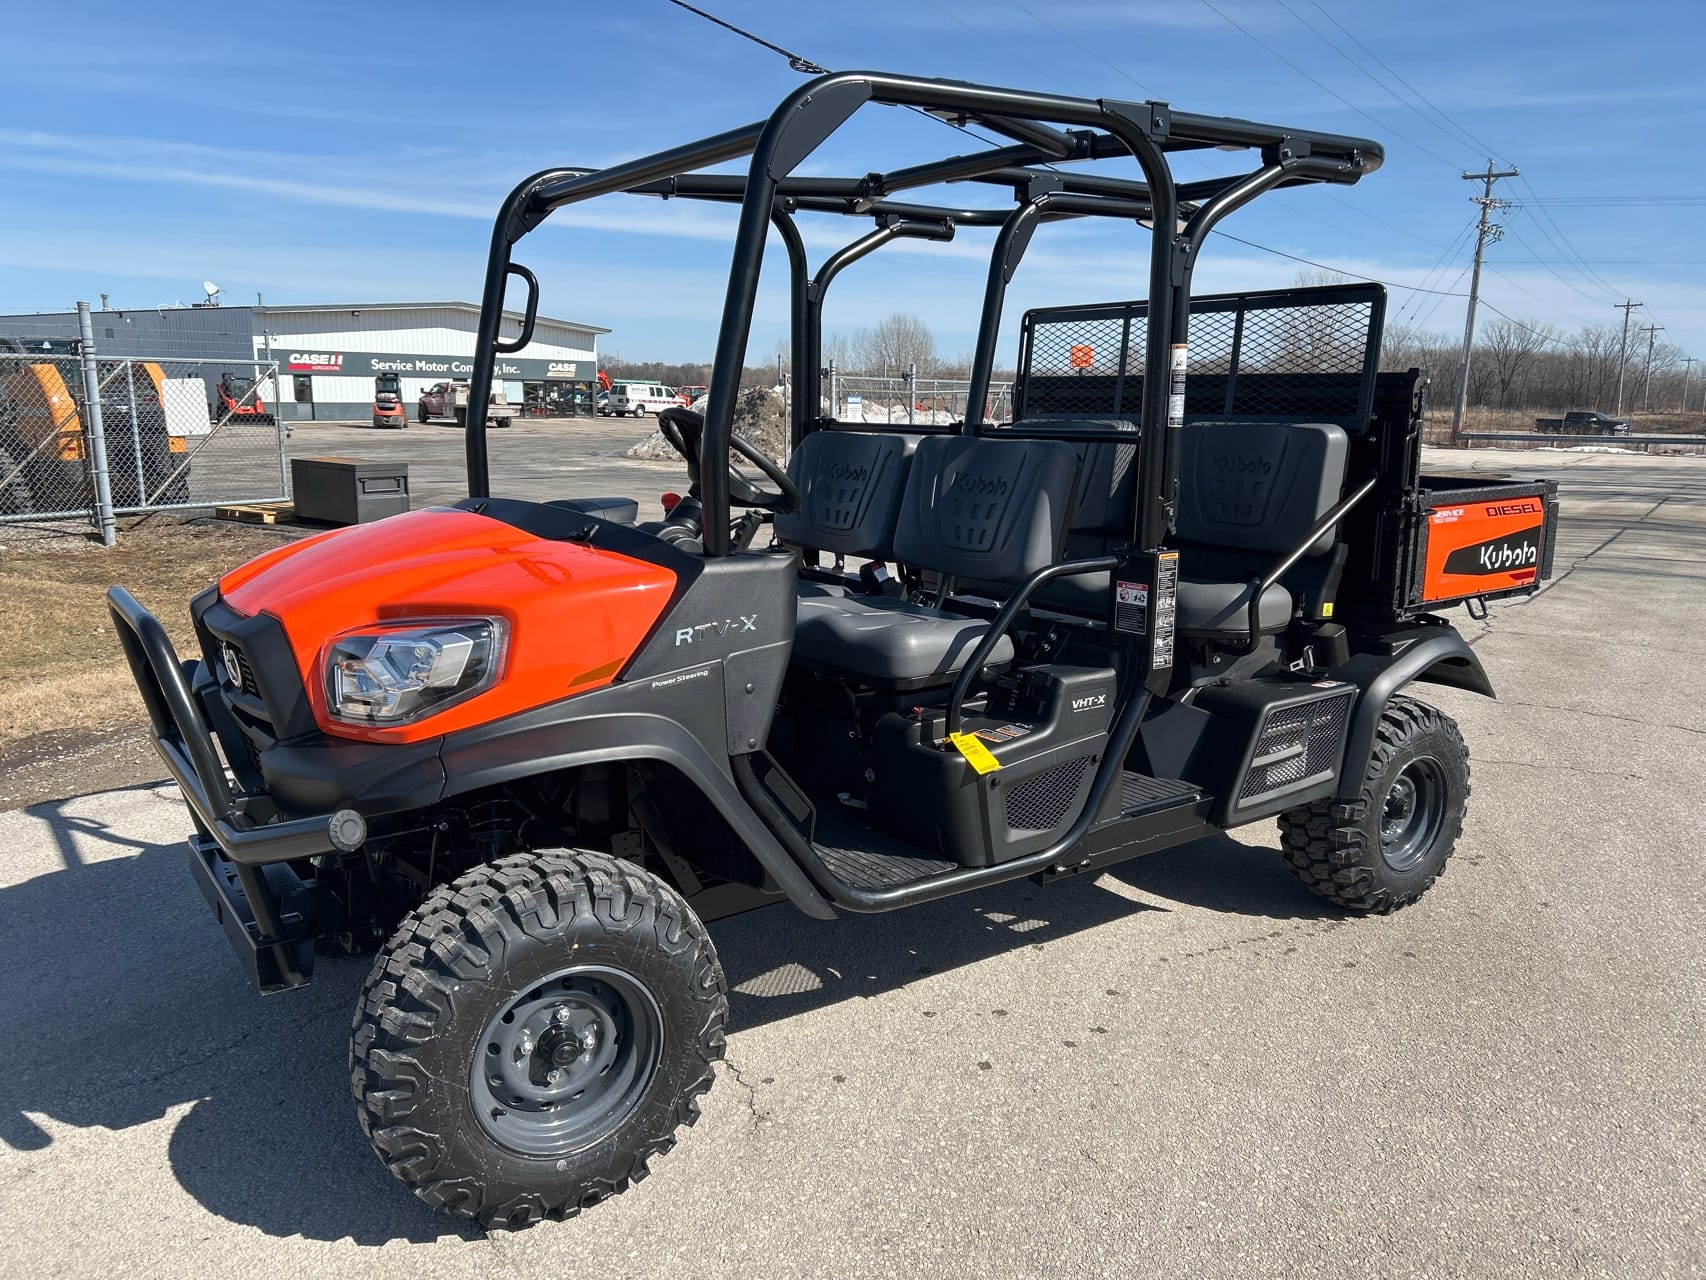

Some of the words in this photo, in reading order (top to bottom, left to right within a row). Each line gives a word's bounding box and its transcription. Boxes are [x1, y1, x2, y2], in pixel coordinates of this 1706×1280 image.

[289, 353, 330, 365] CASE
[370, 359, 414, 371] Service
[415, 360, 449, 372] Motor
[451, 361, 502, 375] Comy,
[502, 363, 521, 374] Inc.
[548, 362, 577, 372] CASE
[950, 471, 1008, 495] Kubota
[1485, 503, 1542, 517] DIESEL
[1480, 540, 1537, 570] Kubota
[675, 614, 758, 647] RTV-X
[1072, 694, 1106, 709] VHT-X
